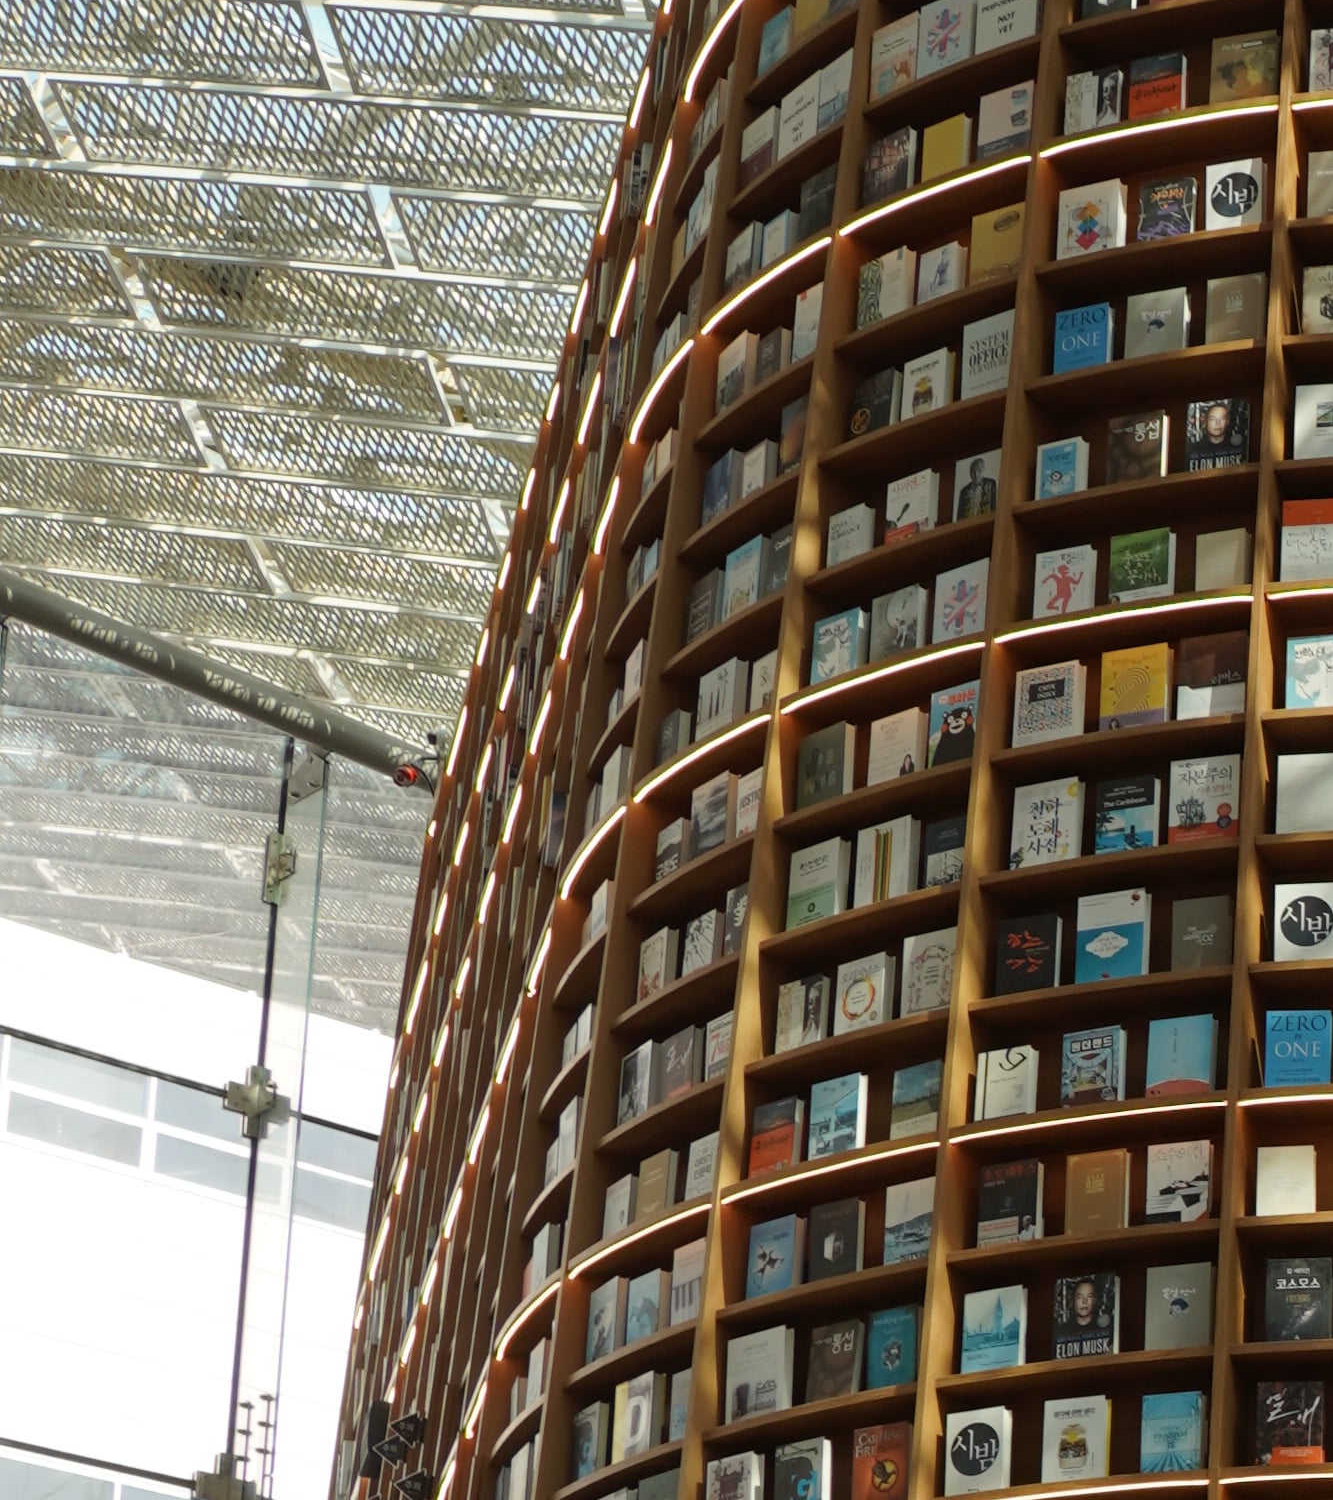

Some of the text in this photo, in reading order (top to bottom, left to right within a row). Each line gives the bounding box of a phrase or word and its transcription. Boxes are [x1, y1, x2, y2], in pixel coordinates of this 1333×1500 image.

[998, 12, 1015, 23] NOT
[999, 24, 1013, 35] YET
[1211, 178, 1258, 212] 시밤
[1059, 309, 1106, 330] ZERO
[970, 331, 1009, 352] SYSTEM
[1062, 331, 1100, 352] ONE
[970, 346, 1009, 367] OFFICE
[970, 358, 1009, 377] FURNITURE
[1134, 419, 1160, 441] 통섭
[1189, 454, 1242, 472] ELON MUSK
[1179, 768, 1232, 784] 자본주의
[1103, 798, 1147, 809] The Caribbean
[1282, 901, 1332, 944] 시밤
[1271, 1015, 1327, 1032] ZERO
[1274, 1041, 1322, 1058] ONE
[1276, 1278, 1320, 1290] 코스모스
[832, 1330, 855, 1354] 통섭
[1056, 1339, 1110, 1359] ELON MUSK
[856, 1445, 878, 1457] FIRE
[953, 1428, 999, 1472] 시밤
